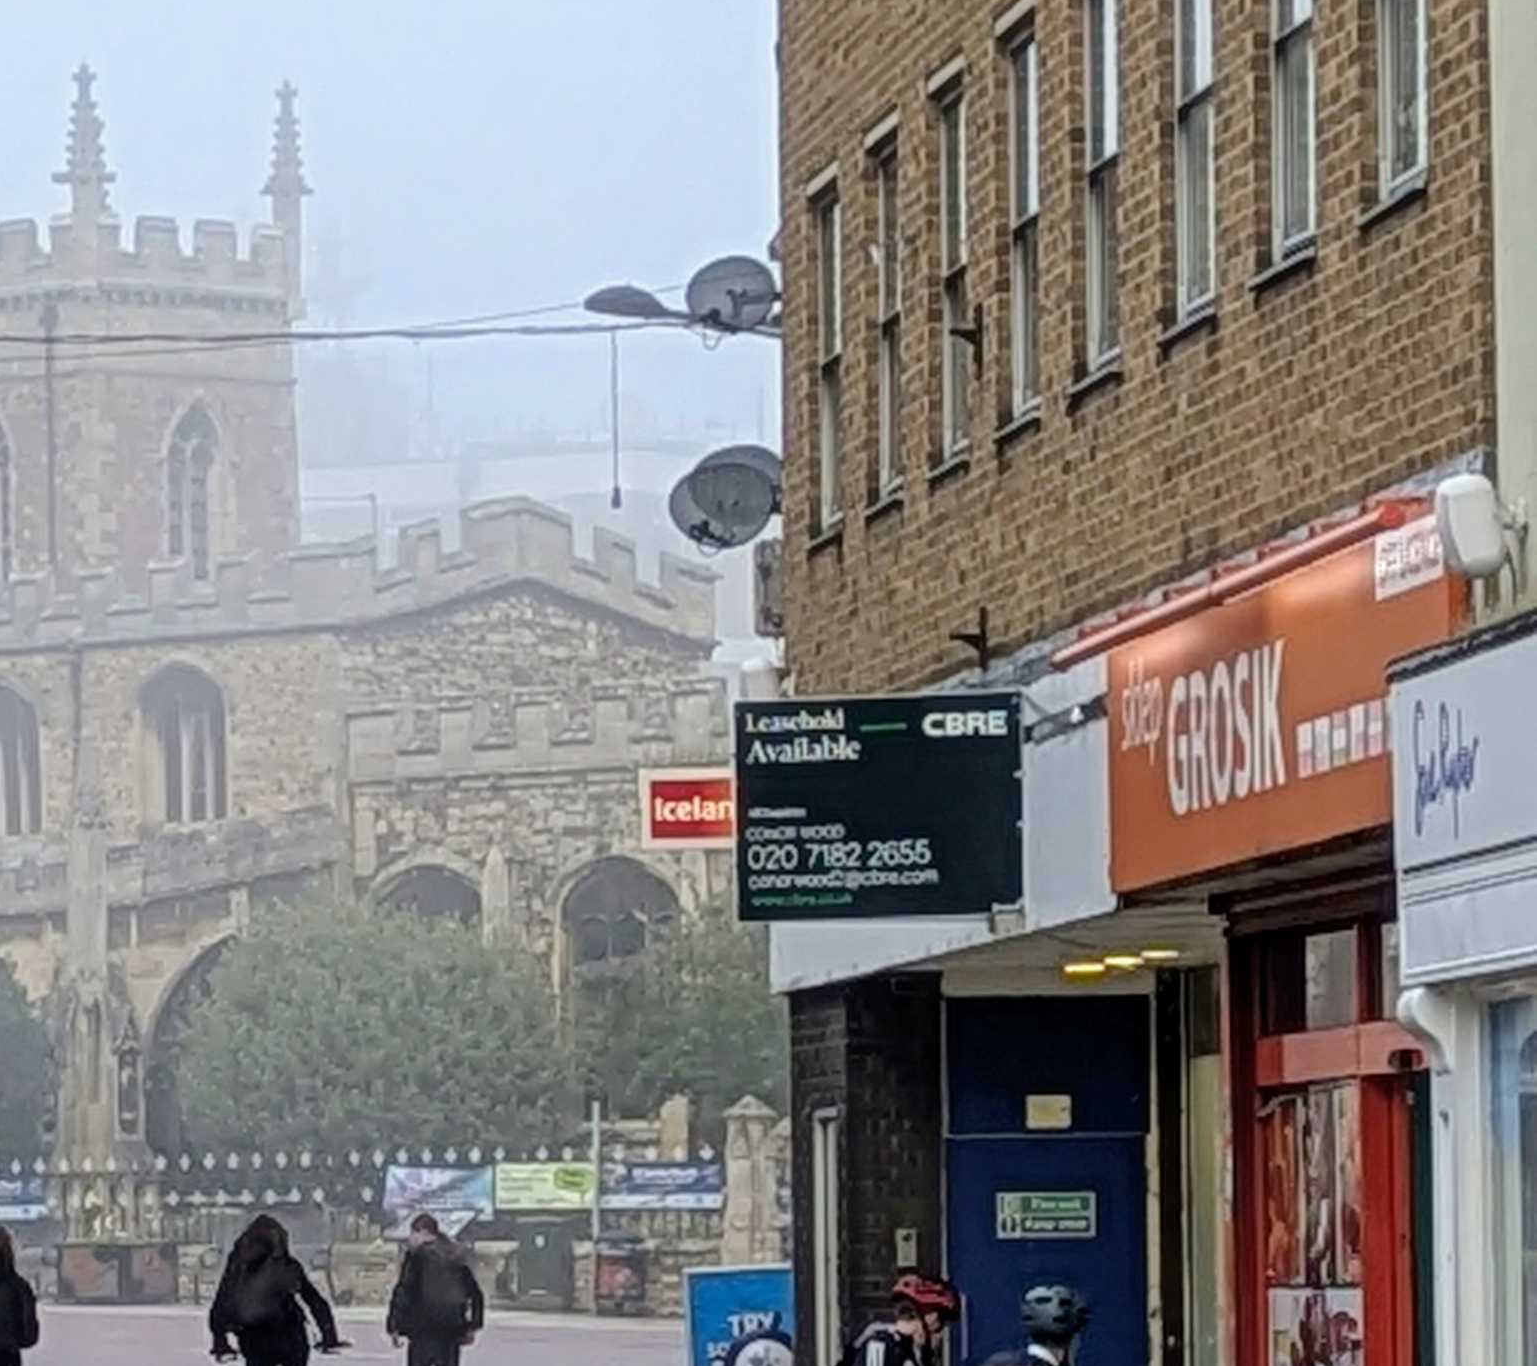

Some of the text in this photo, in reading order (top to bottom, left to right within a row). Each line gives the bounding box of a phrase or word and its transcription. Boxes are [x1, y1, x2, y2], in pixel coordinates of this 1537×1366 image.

[745, 708, 845, 733] Leasehold
[922, 710, 1008, 736] CBRE
[1167, 639, 1286, 816] GROSIK
[746, 735, 861, 765] Available
[654, 796, 733, 823] Icelan
[747, 838, 932, 870] 020 7182 2655
[726, 1311, 775, 1337] TRY
